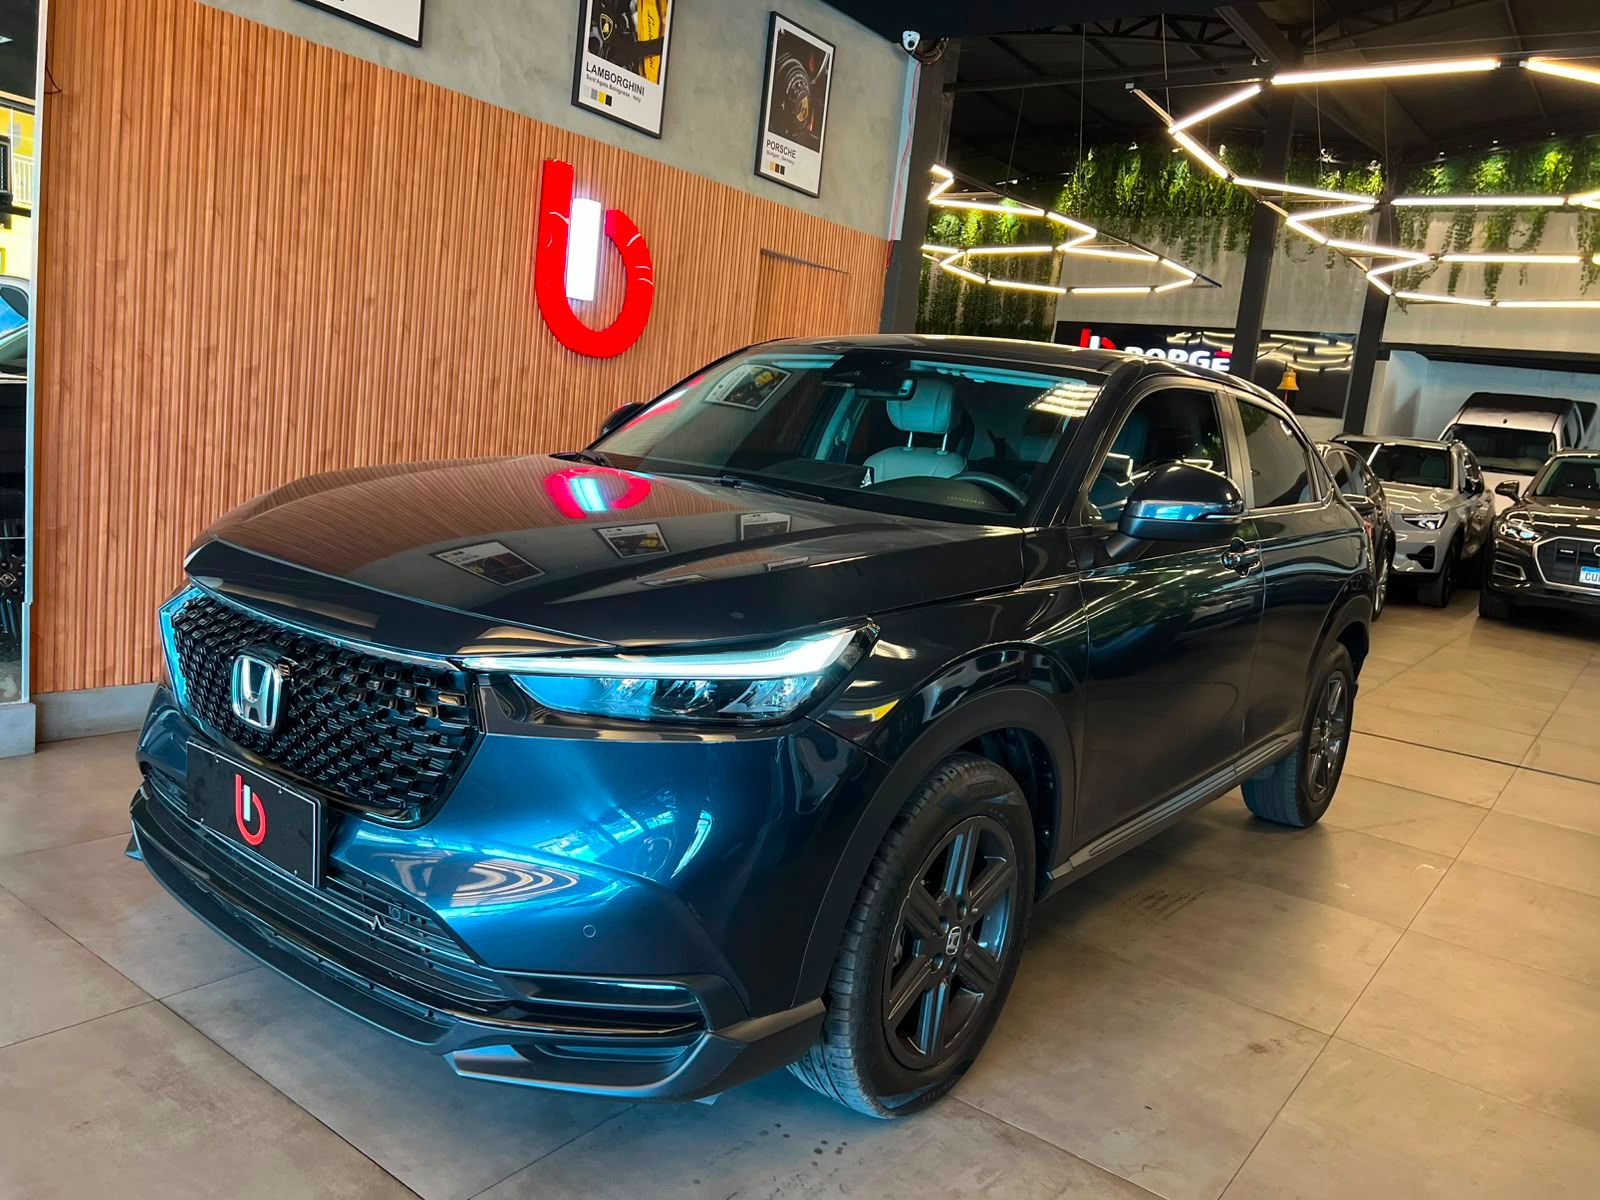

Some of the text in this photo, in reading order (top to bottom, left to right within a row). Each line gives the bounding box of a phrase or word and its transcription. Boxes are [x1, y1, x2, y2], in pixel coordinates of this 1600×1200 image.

[586, 61, 645, 96] LAMBORGHINI
[766, 139, 797, 159] PORSCHE
[1584, 572, 1600, 583] CU
